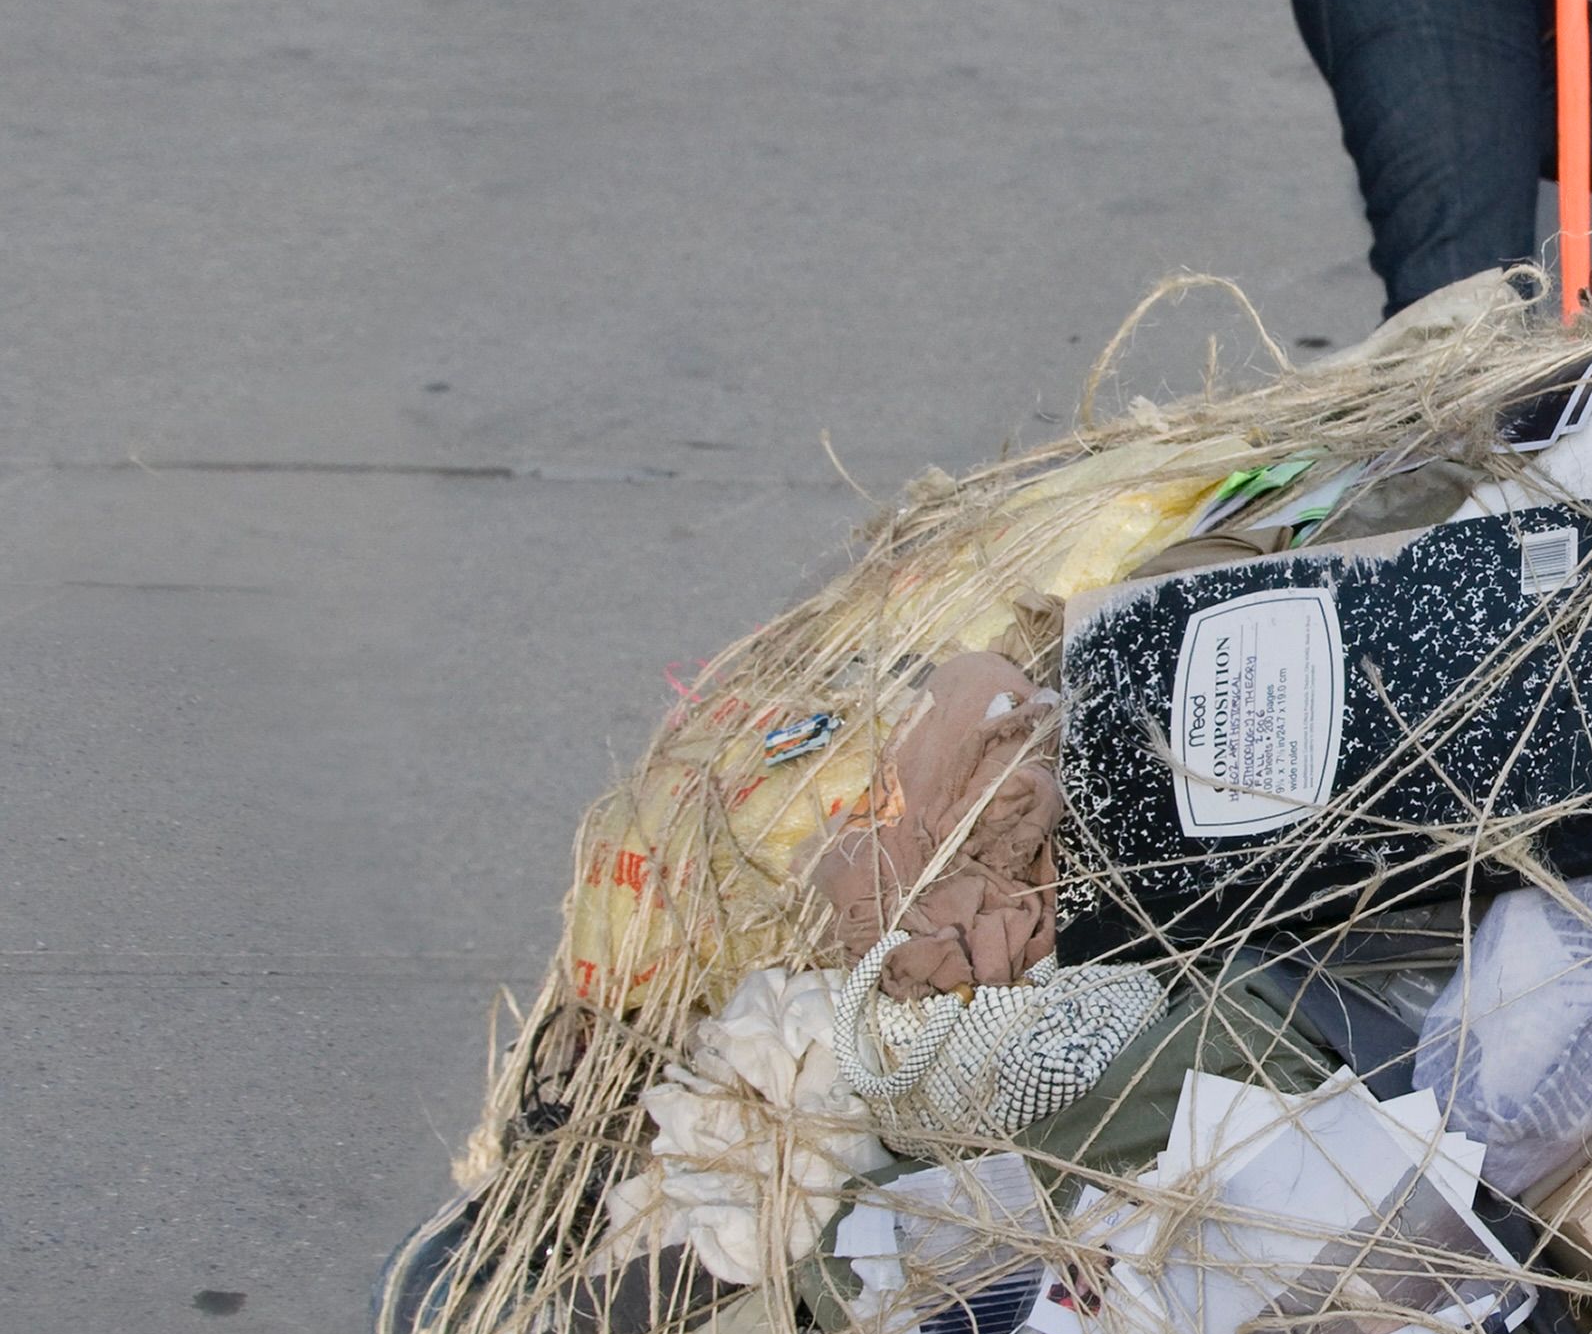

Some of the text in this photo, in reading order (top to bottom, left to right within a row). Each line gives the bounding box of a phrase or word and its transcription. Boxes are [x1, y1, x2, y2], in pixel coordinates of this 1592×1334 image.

[1245, 656, 1256, 705] THEORY
[1279, 668, 1287, 683] cm
[1267, 684, 1275, 713] pages
[1189, 695, 1206, 747] Mead
[1265, 716, 1274, 732] 200
[1264, 743, 1273, 775] sheets
[1289, 740, 1298, 791] wide ruled
